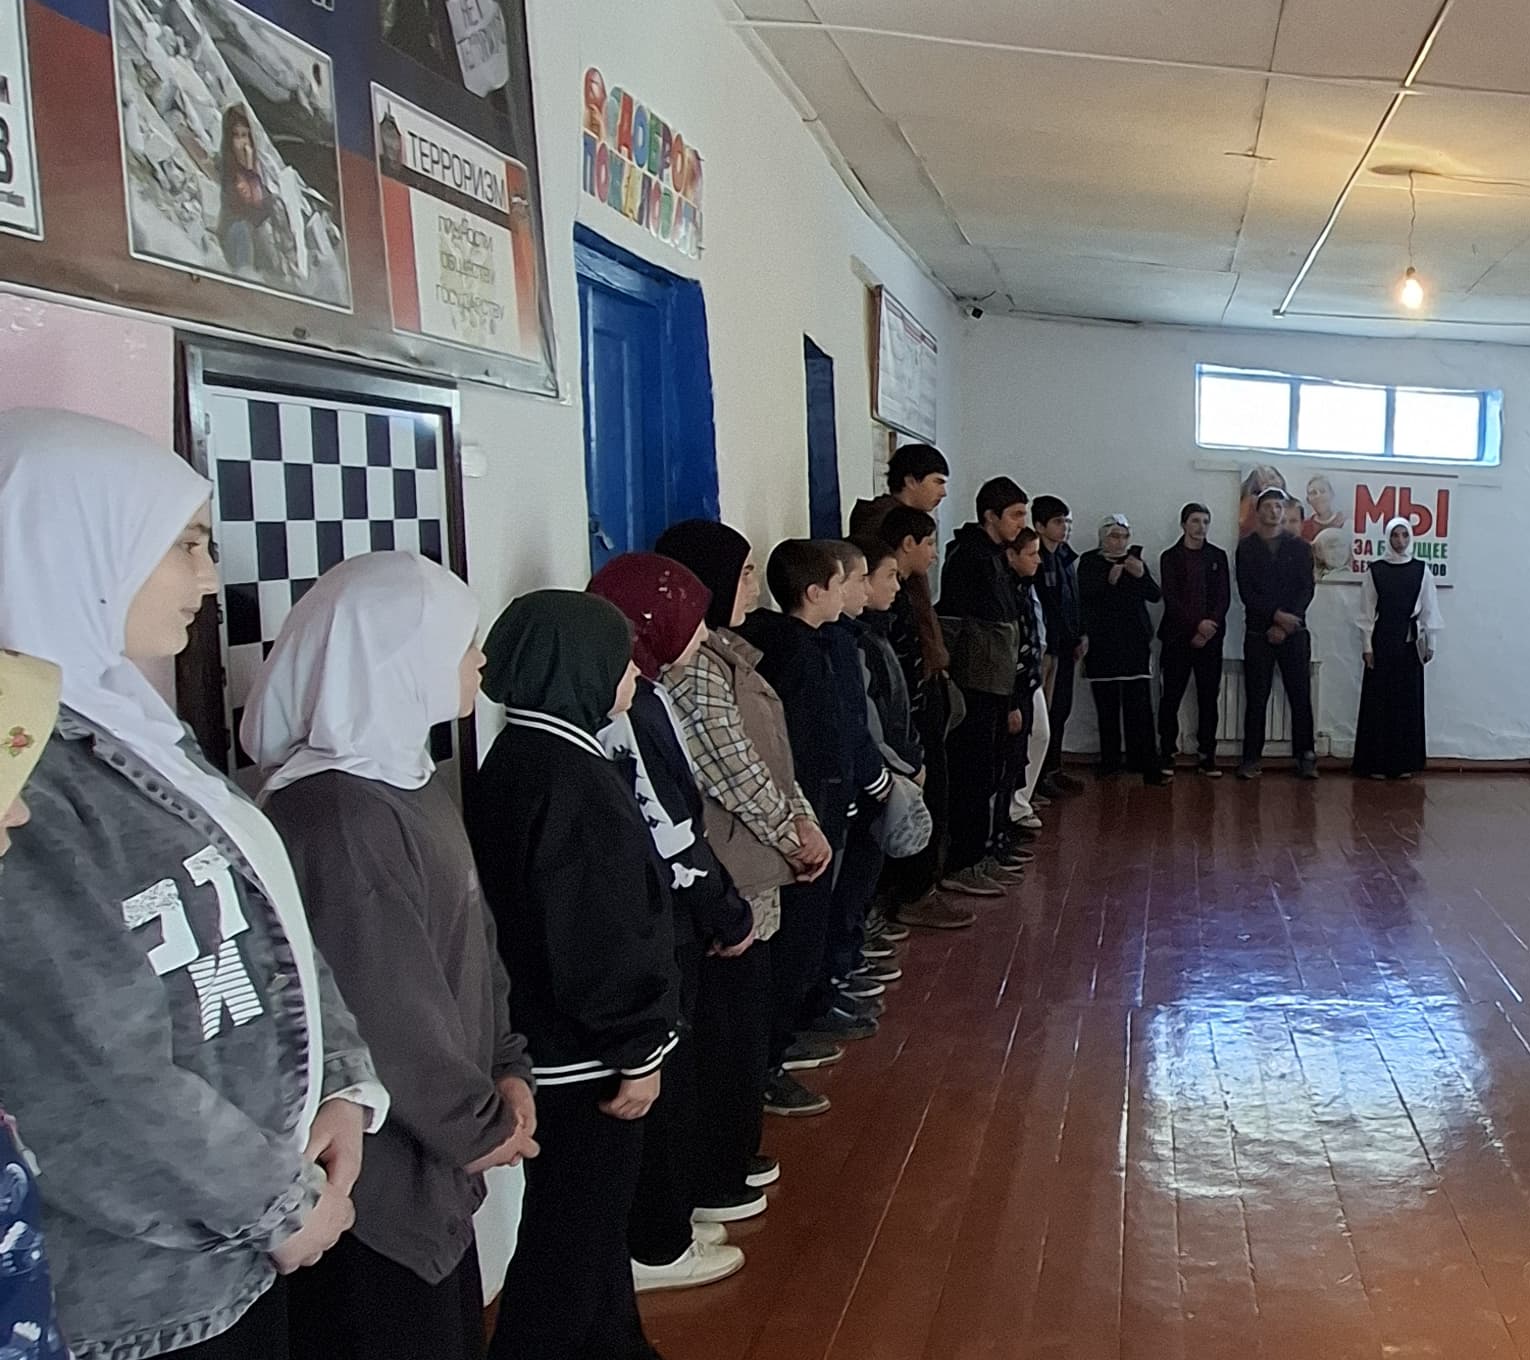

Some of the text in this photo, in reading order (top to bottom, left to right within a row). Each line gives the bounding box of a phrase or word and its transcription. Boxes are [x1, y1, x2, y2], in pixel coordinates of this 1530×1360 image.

[407, 130, 506, 206] ТЕРРОРИЗМ
[1353, 483, 1451, 539] МЫ
[1353, 538, 1374, 557] ЗА
